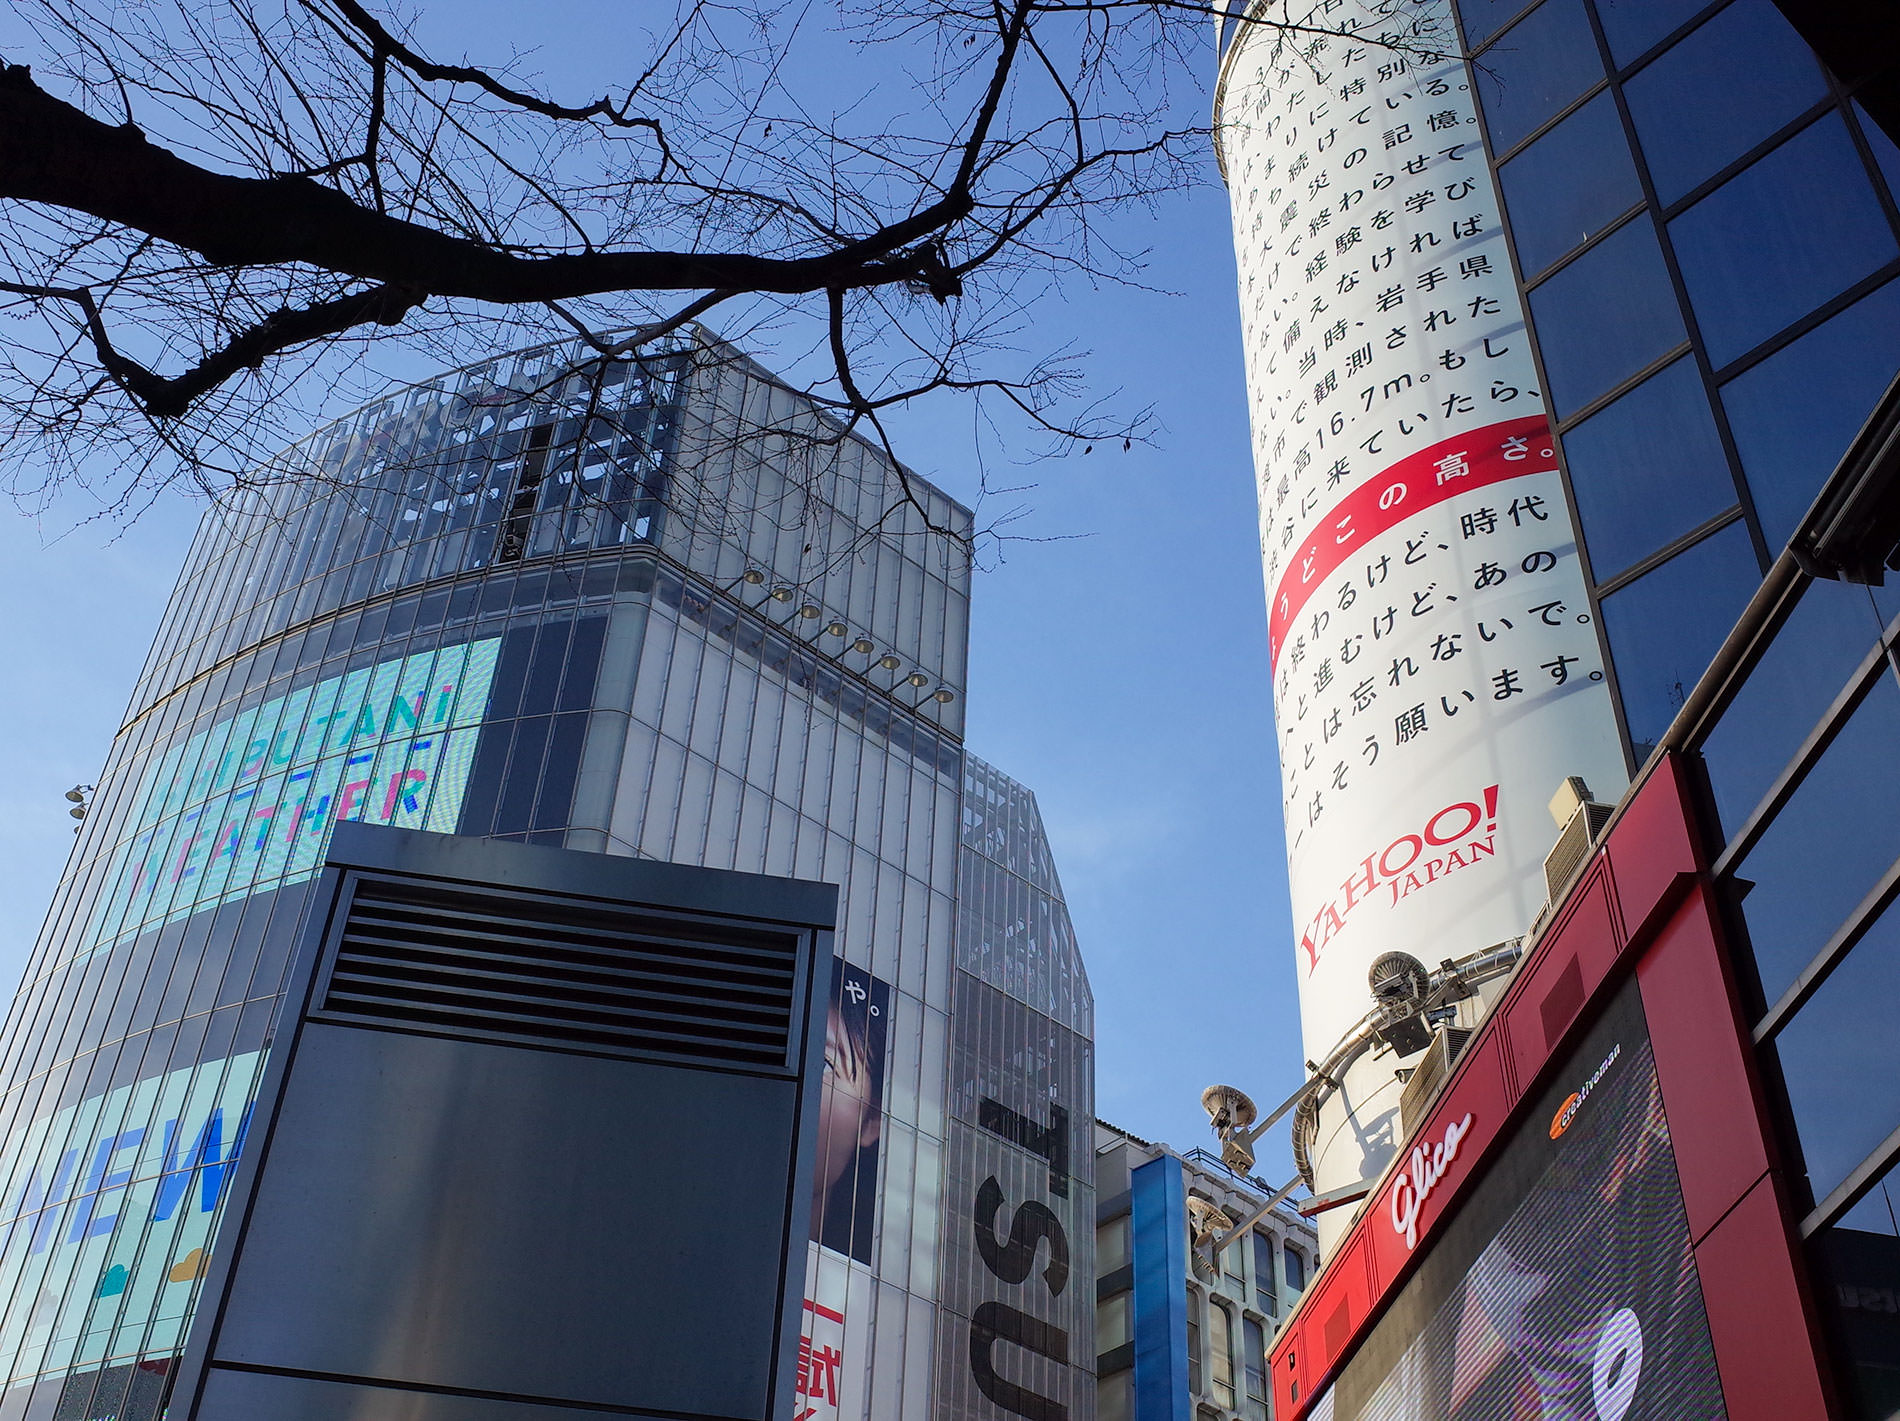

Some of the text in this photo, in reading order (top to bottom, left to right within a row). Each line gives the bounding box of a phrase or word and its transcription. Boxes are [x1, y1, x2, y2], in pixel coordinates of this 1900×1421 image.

[1300, 783, 1500, 978] YAHOO!
[1387, 834, 1497, 909] JAPAN
[1561, 1043, 1621, 1128] creativeman
[1391, 1112, 1472, 1251] Glico
